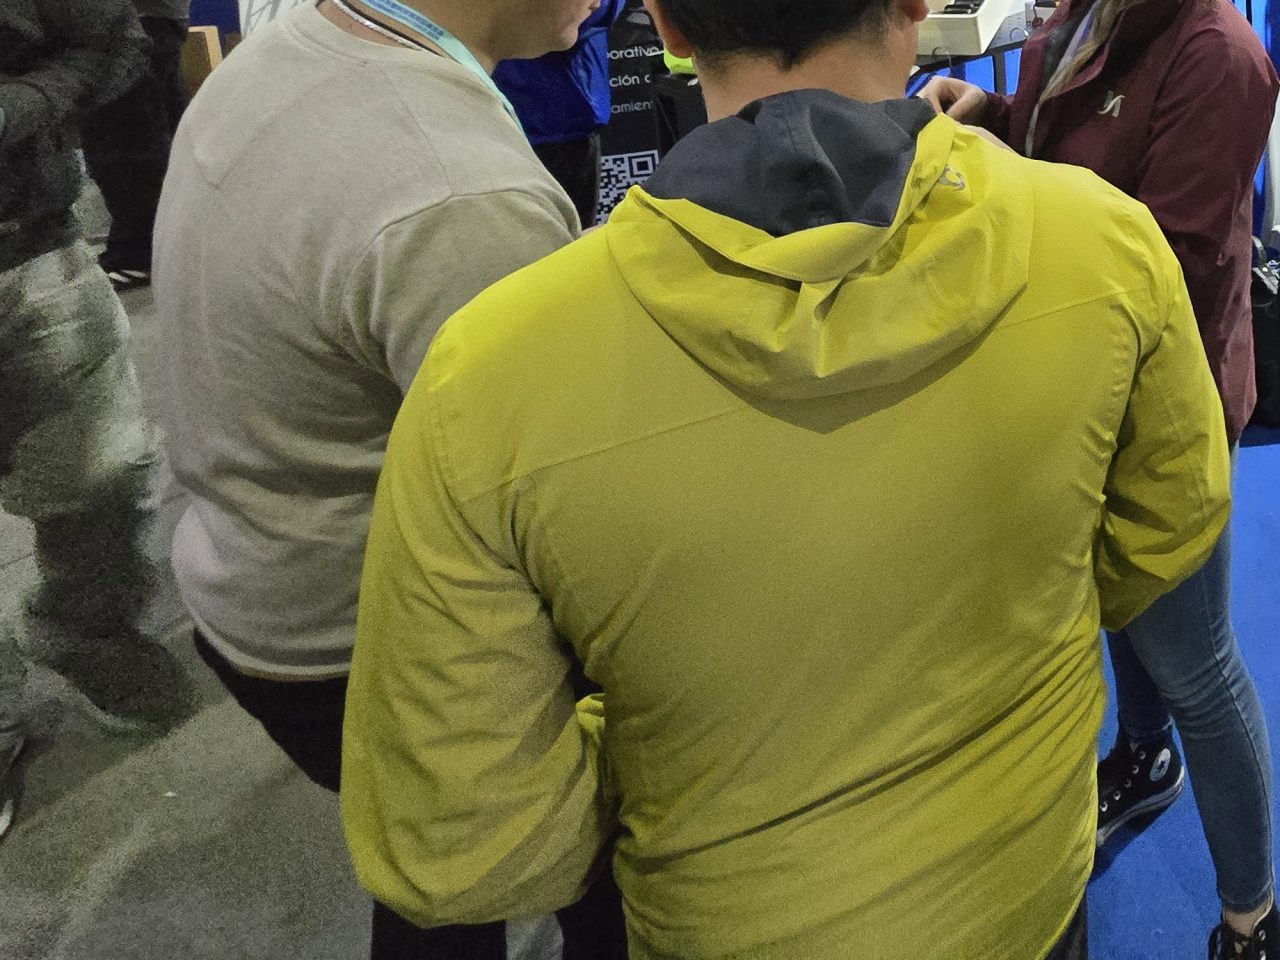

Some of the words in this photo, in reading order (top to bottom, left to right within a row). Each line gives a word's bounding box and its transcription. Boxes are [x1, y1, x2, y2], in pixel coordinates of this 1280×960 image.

[607, 45, 660, 60] orativo
[609, 74, 640, 88] ción
[611, 100, 654, 115] amien
